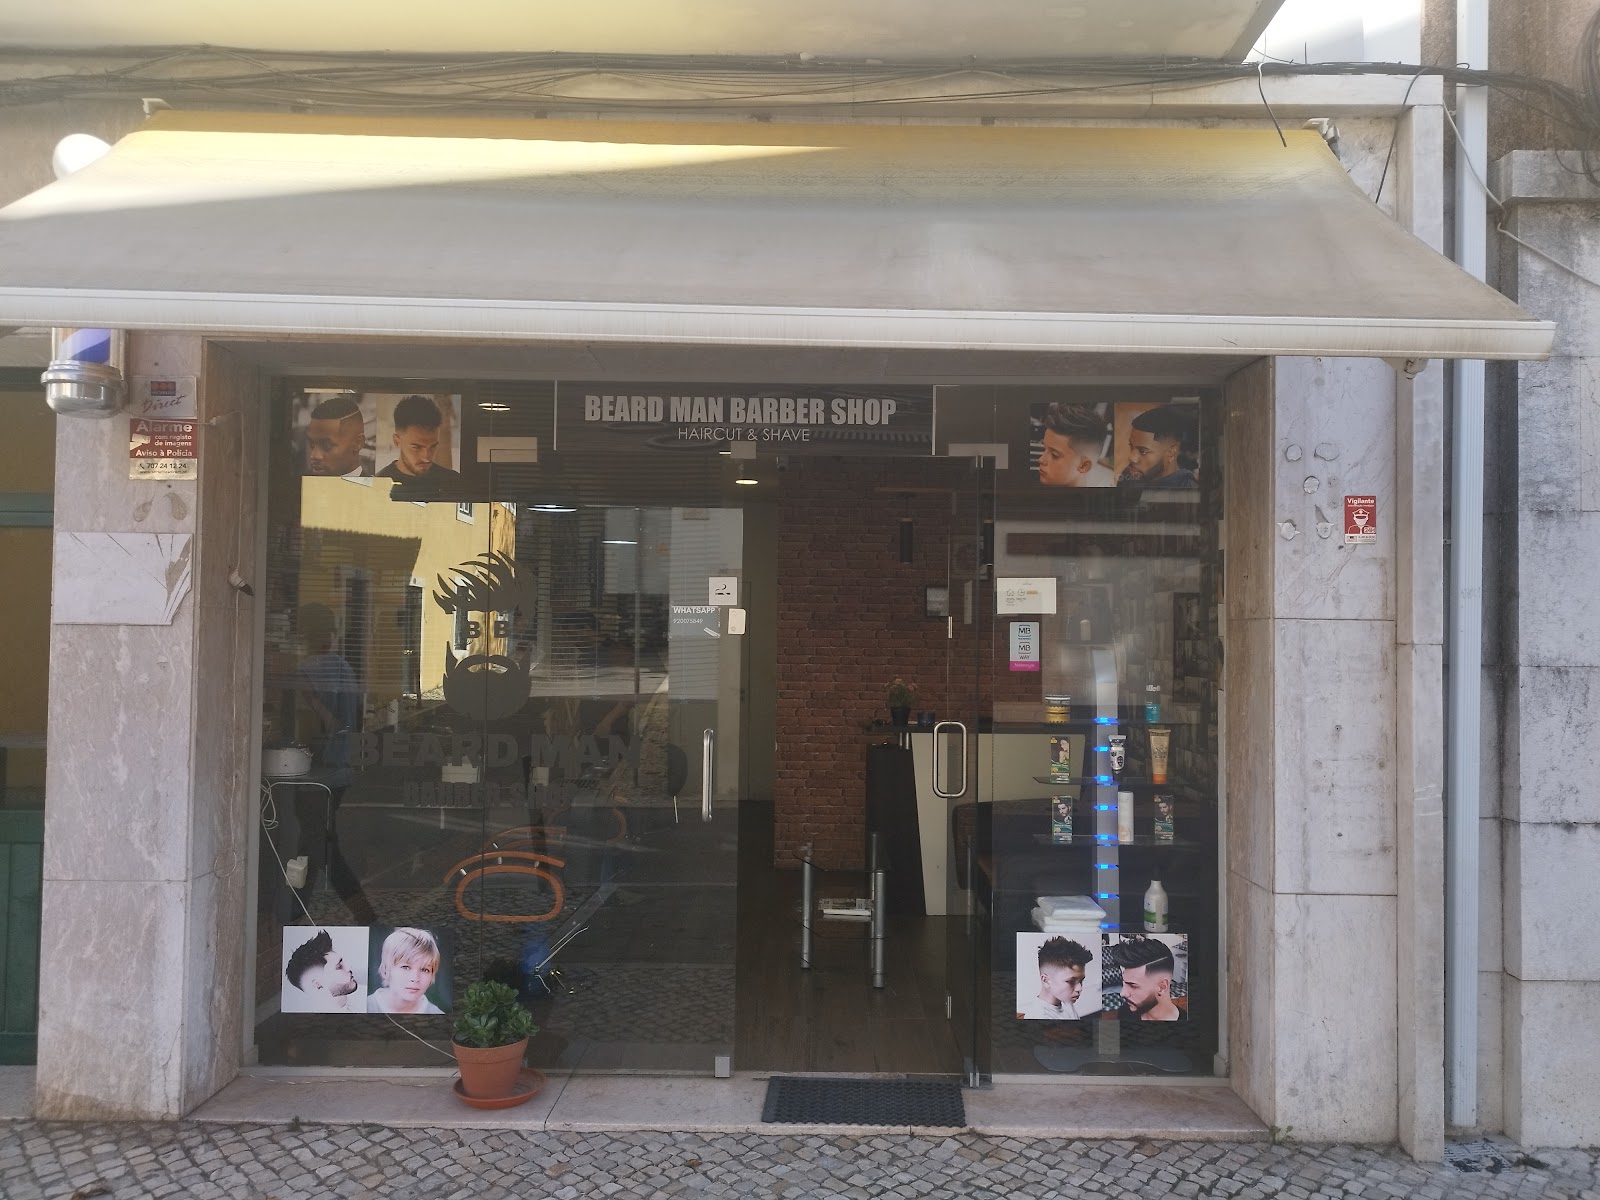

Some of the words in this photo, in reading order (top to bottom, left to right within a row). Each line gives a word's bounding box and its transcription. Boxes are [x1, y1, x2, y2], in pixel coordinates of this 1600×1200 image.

[584, 394, 664, 423] BEARD
[669, 396, 724, 424] MAN
[729, 397, 826, 425] BARBER
[830, 398, 897, 426] SHOP
[136, 420, 193, 433] Alarme
[678, 427, 743, 441] HAIRCUT
[748, 428, 759, 441] &
[762, 428, 810, 442] SHAVE
[135, 449, 158, 457] Aviso
[1347, 497, 1375, 505] Vigilante
[1018, 627, 1031, 635] MB
[1018, 644, 1031, 652] MB
[350, 732, 518, 768] BEARD
[531, 733, 641, 769] MAN
